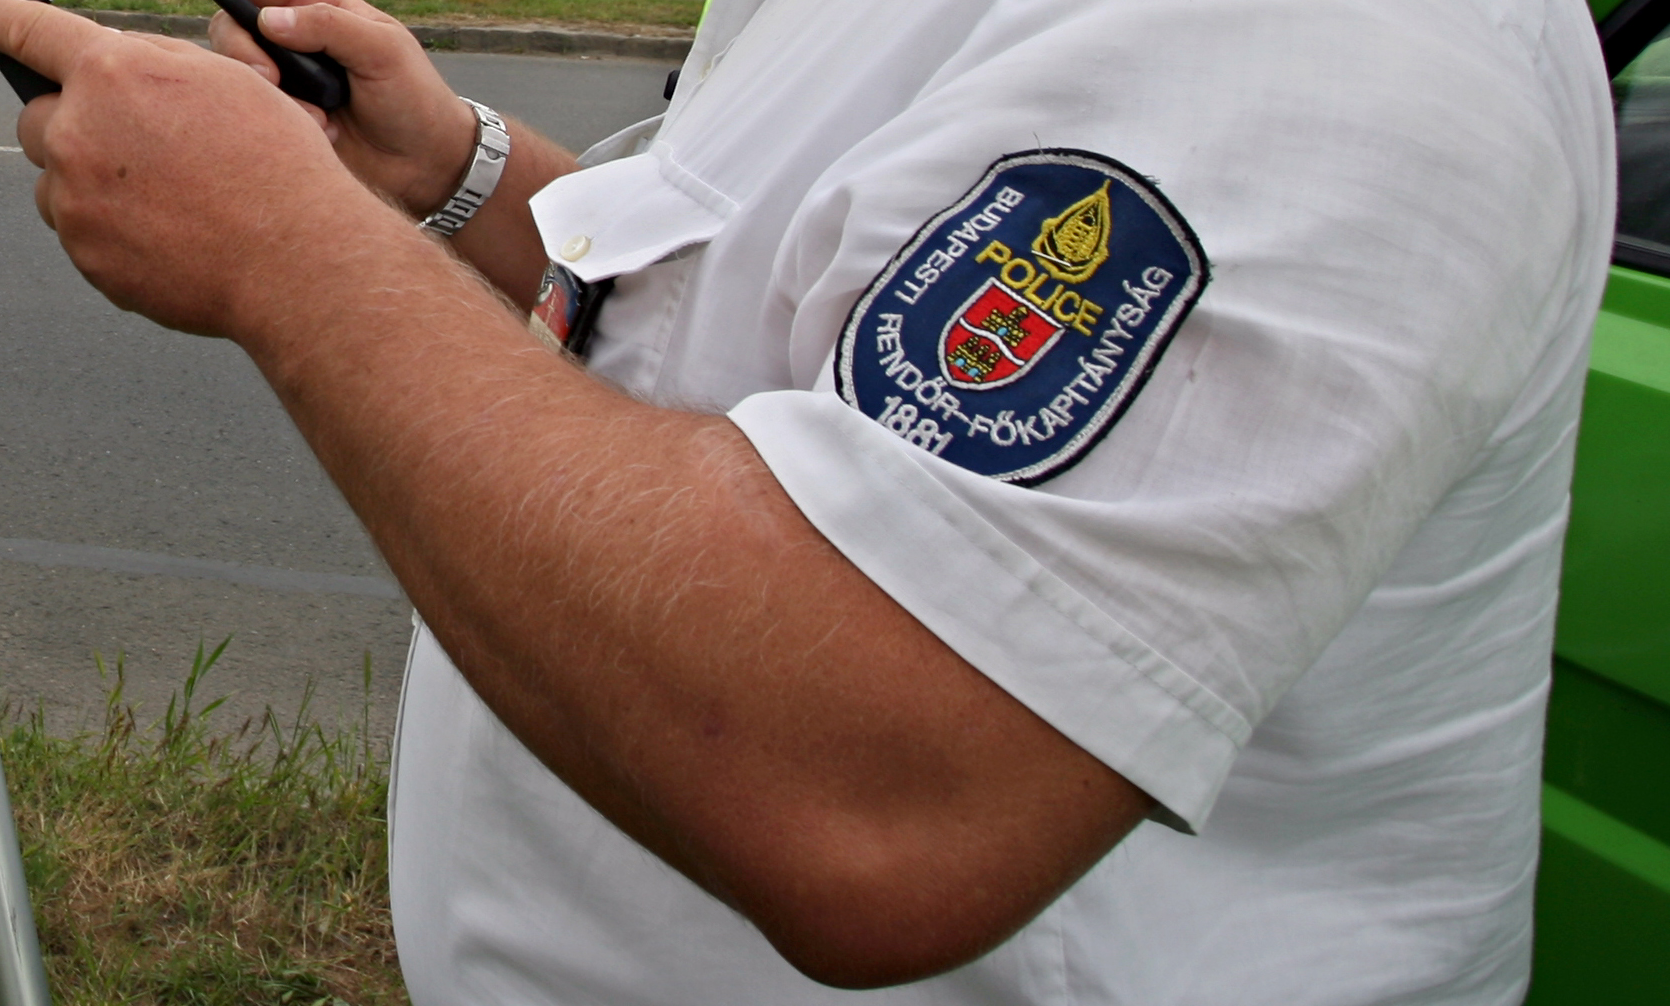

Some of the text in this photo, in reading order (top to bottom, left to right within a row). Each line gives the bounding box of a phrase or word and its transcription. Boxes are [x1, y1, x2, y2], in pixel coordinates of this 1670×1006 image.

[895, 186, 1025, 305] BUDAPESTI
[974, 240, 1103, 336] POLICE
[876, 396, 953, 457] 1881
